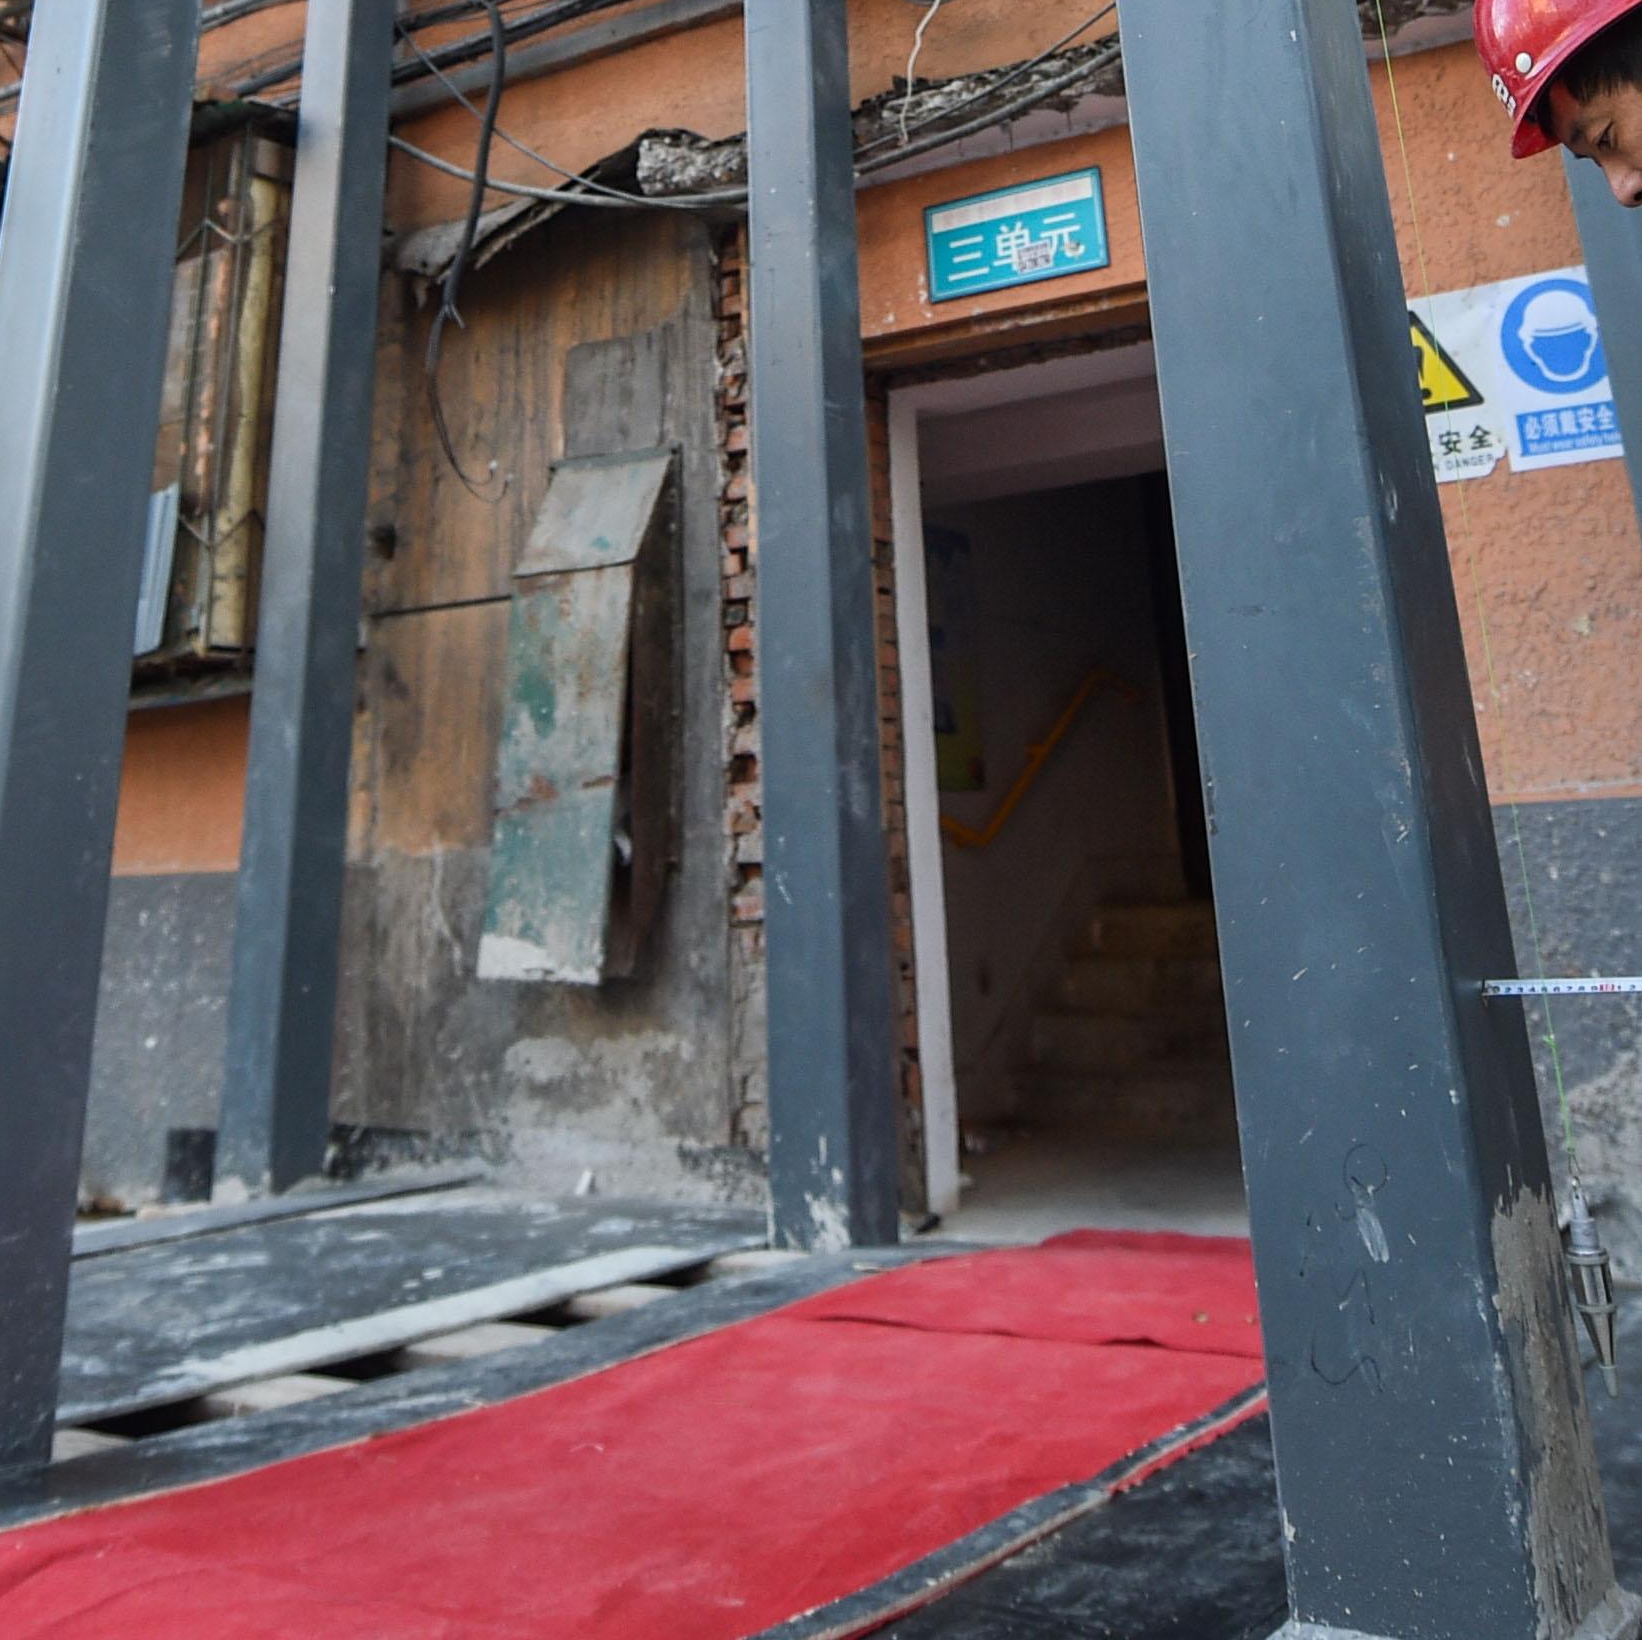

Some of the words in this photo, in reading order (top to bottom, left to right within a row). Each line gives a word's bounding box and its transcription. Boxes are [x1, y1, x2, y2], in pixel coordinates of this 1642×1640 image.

[948, 212, 1085, 282] 三单元
[1445, 454, 1494, 470] DANGER
